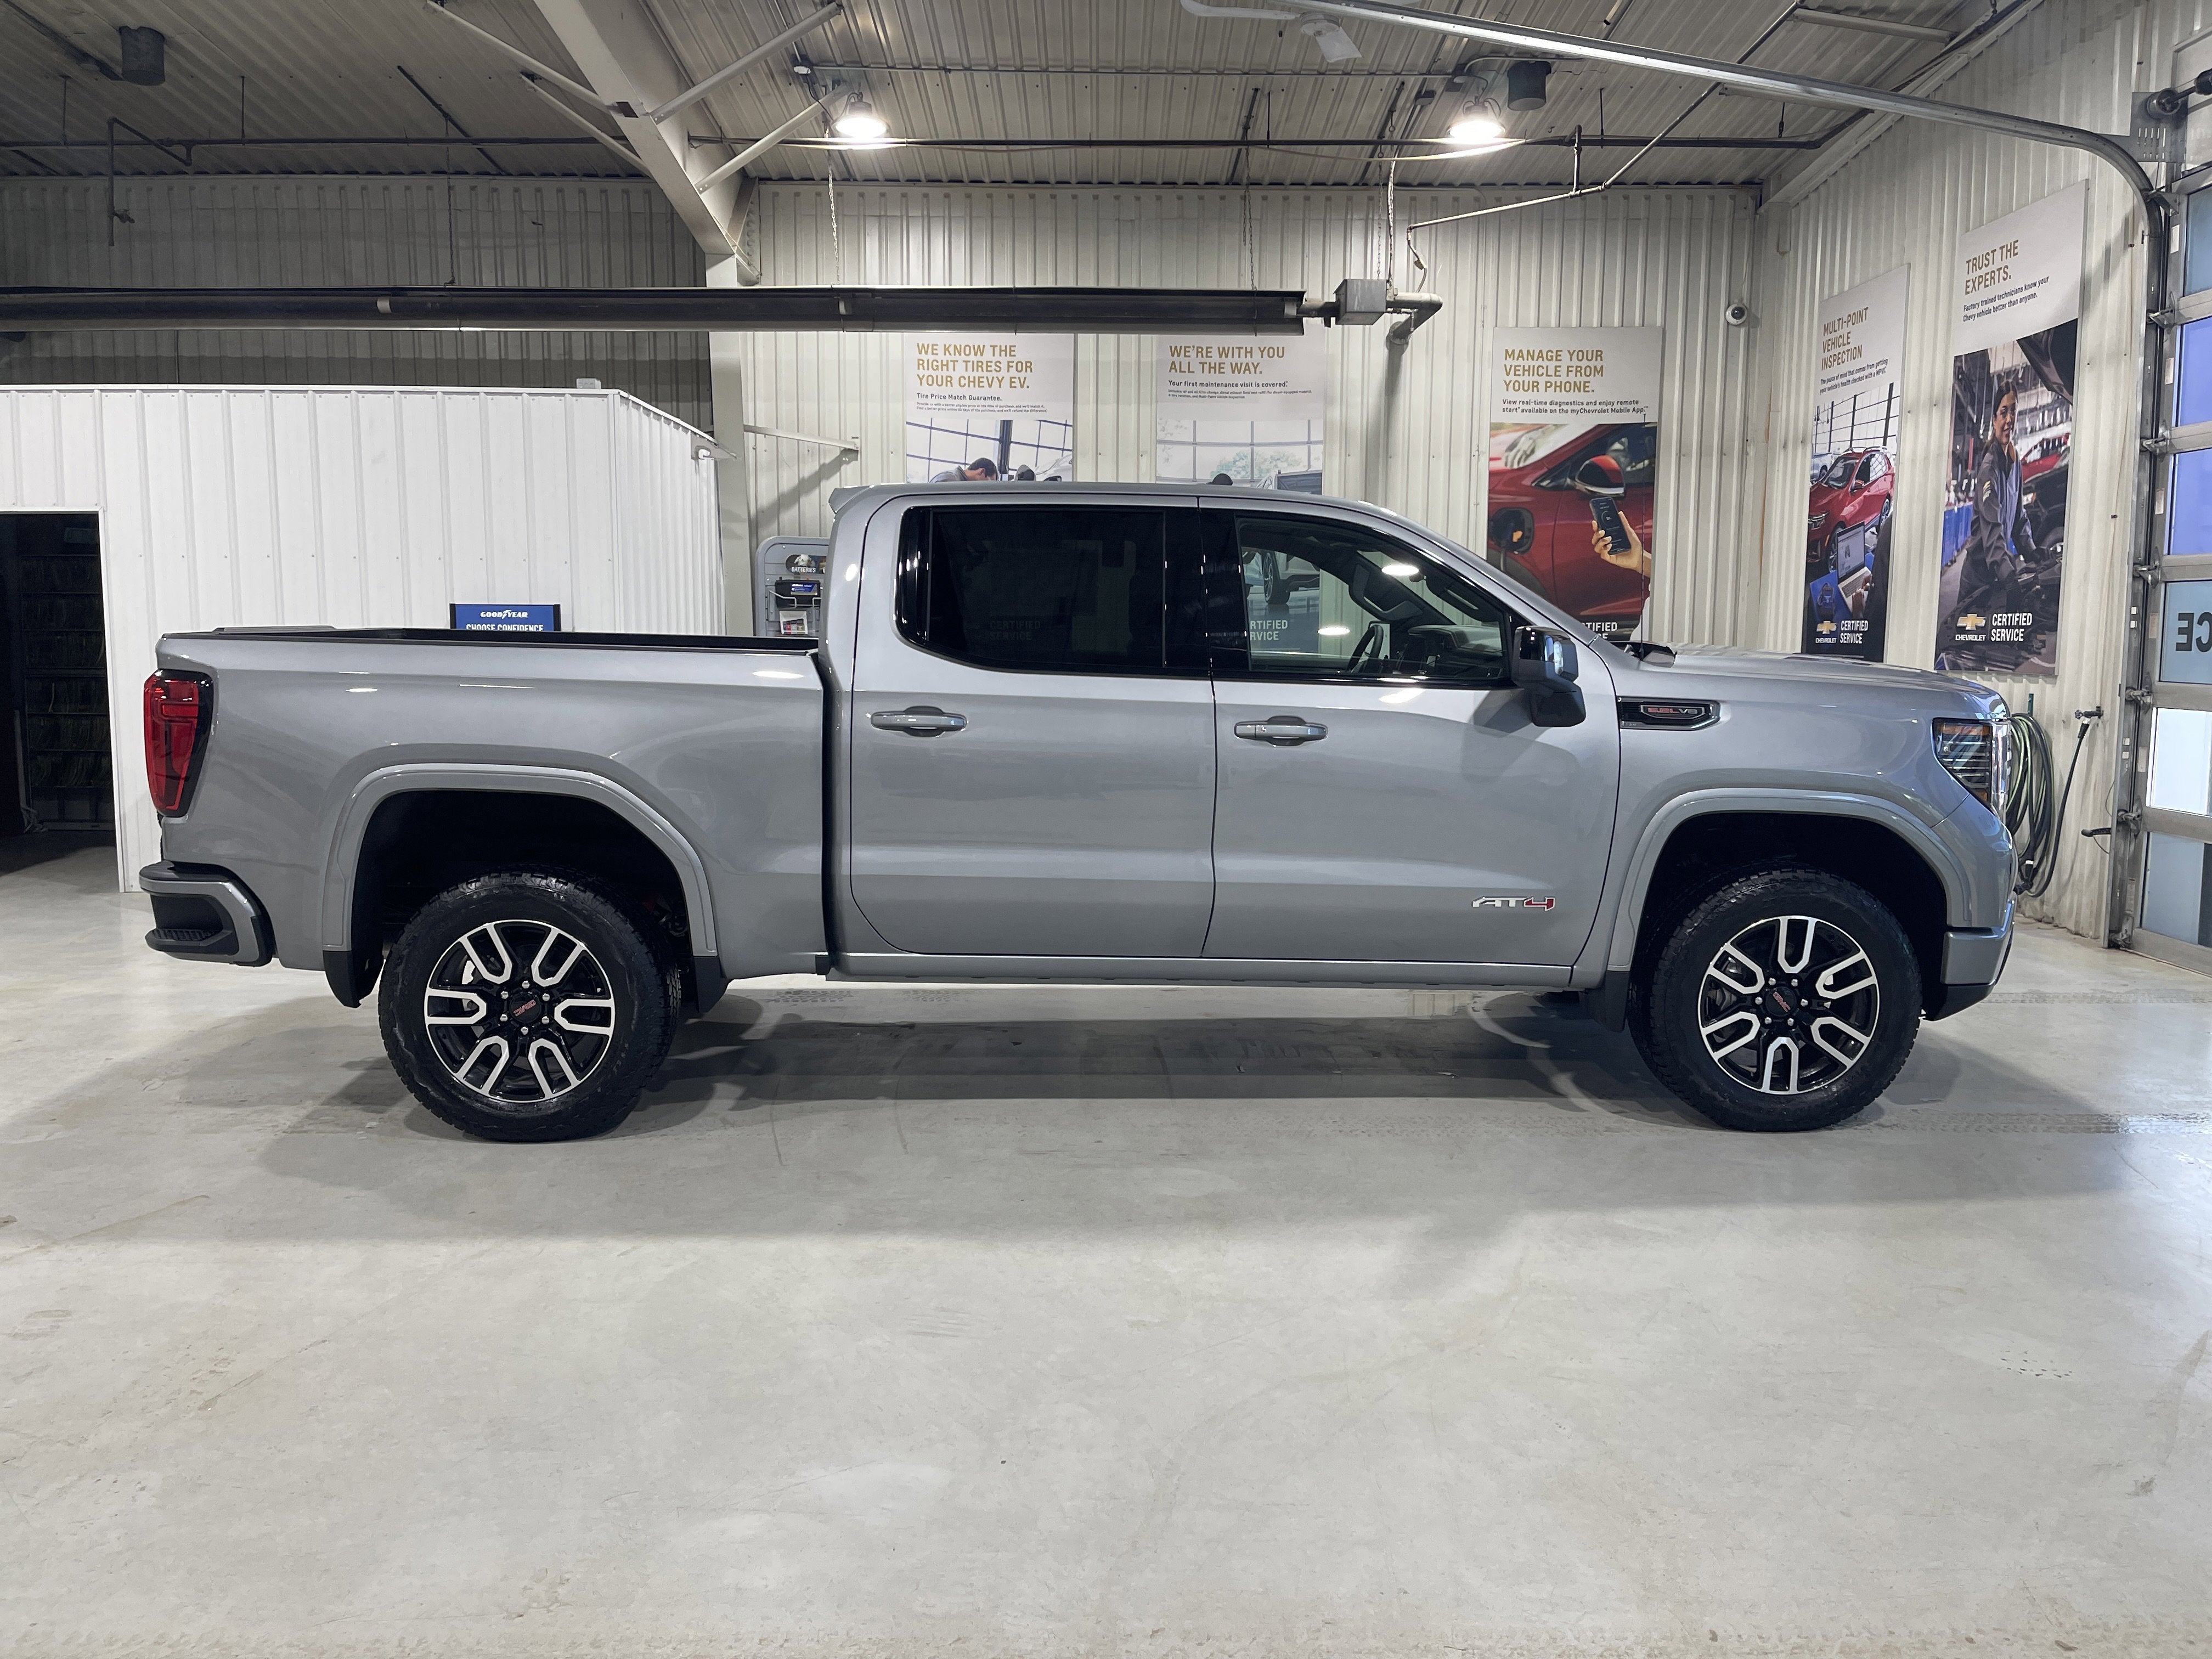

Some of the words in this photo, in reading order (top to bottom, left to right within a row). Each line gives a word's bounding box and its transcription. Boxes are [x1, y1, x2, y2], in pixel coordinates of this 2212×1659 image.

[1966, 249, 1996, 275] TRUST
[1999, 239, 2019, 262] THE
[1965, 265, 2012, 295] EXPERTS.
[1963, 302, 1979, 312] Factory
[1980, 295, 1996, 307] trained
[1997, 286, 2023, 301] technicians
[2024, 281, 2037, 291] know
[2038, 276, 2050, 288] your
[1963, 313, 1976, 321] Chevy
[1977, 307, 1992, 318] vehicle
[1993, 302, 2007, 313] better
[2008, 299, 2018, 308] than
[2019, 292, 2038, 304] anyone.
[1823, 306, 1869, 336] MULTI-POINT
[1822, 331, 1851, 353] VEHICLE
[917, 343, 939, 356] WE
[944, 344, 985, 357] KNOW
[990, 345, 1016, 357] THE
[1169, 345, 1213, 358] WE'RE
[1217, 346, 1253, 359] WITH
[1257, 346, 1285, 359] YOU
[1505, 348, 1563, 362] MANAGE
[1567, 349, 1604, 362] YOUR
[1821, 345, 1863, 371] INSPECTION
[917, 358, 958, 372] RIGHT
[963, 360, 1002, 373] TIRES
[1007, 360, 1033, 373] FOR
[1169, 360, 1195, 373] ALL
[1199, 362, 1226, 374] THE
[1229, 362, 1262, 374] WAY.
[1504, 364, 1562, 377] VEHICLE
[1566, 365, 1604, 377] FROM
[917, 374, 953, 387] YOUR
[958, 375, 1005, 388] CHEVY
[1009, 376, 1030, 388] EV.
[1503, 380, 1539, 392] YOUR
[1544, 381, 1594, 393] PHONE.
[480, 610, 528, 619] GOODYEAR
[1992, 613, 2033, 627] CERTIFIED
[1250, 620, 1288, 630] RTIFIED
[1581, 622, 1618, 631] TIFIED
[1841, 620, 1869, 631] CERTIFIED
[1250, 631, 1279, 641] RVICE
[1839, 633, 1863, 644] SERVICE
[1991, 628, 2024, 641] SERVICE
[1472, 896, 1555, 911] AT4
